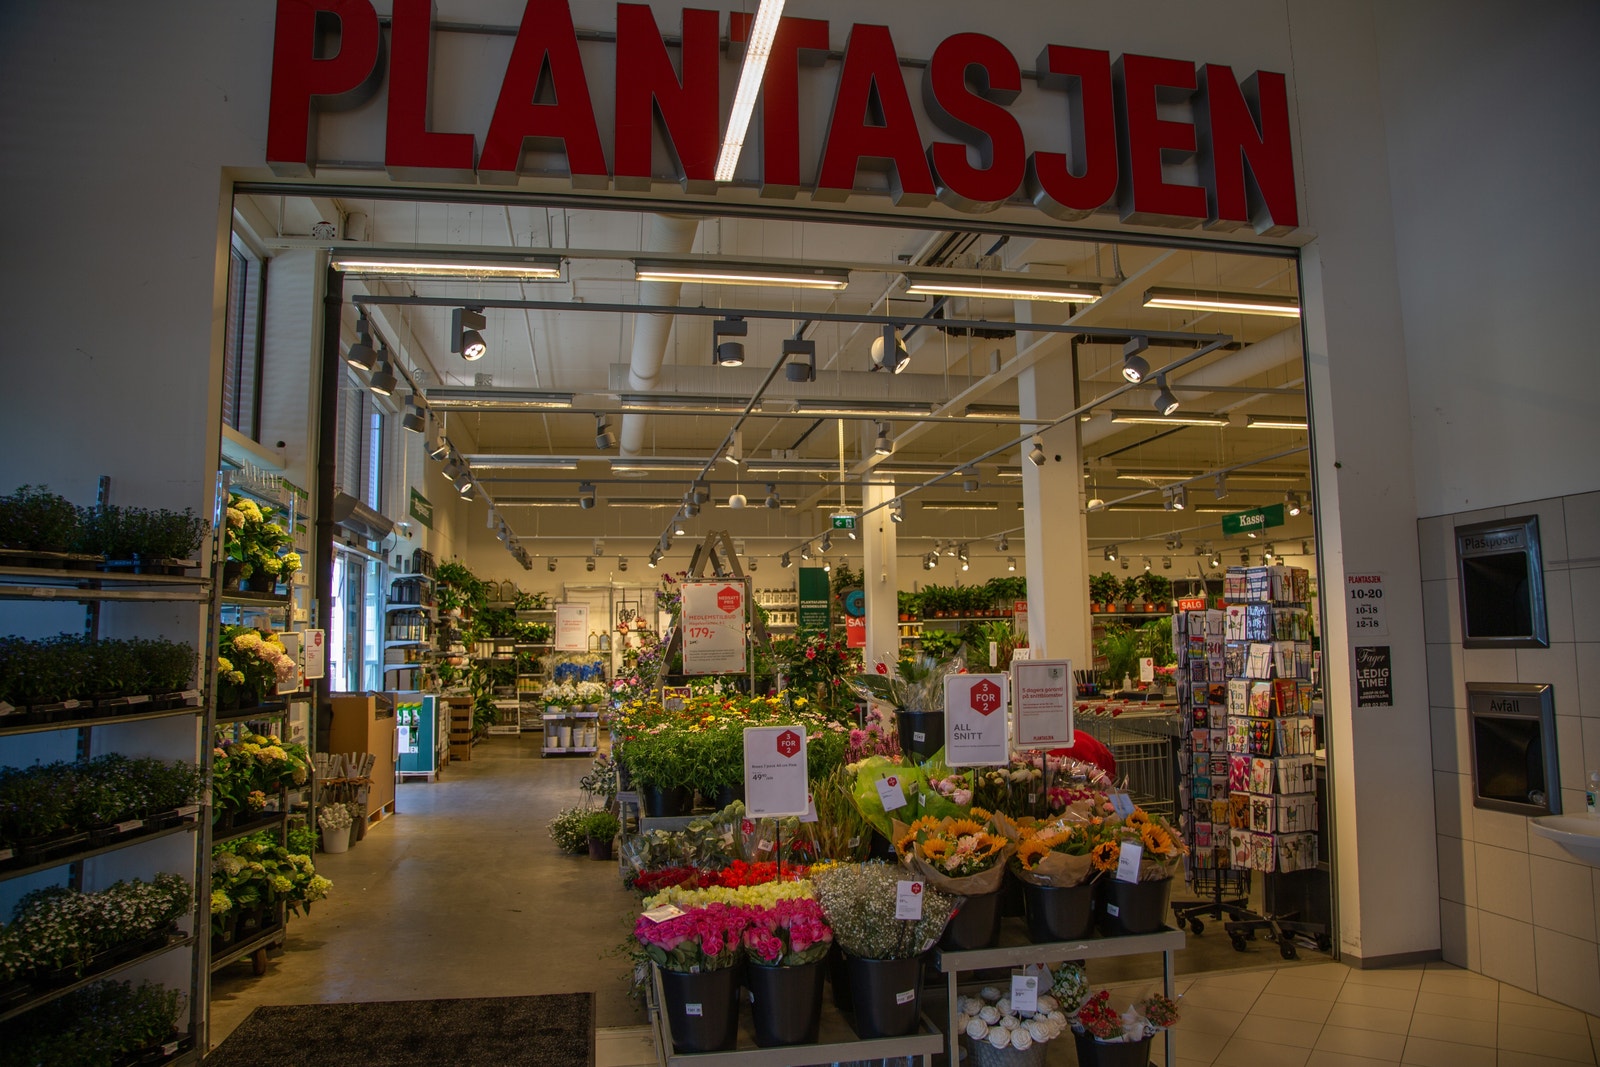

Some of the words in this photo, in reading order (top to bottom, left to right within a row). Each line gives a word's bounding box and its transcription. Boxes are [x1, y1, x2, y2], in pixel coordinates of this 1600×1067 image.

[267, 0, 1299, 230] PLANTASJEN
[1239, 514, 1265, 527] Kasse
[1465, 532, 1520, 550] Plastposer
[1348, 576, 1382, 584] PLANTASJEN
[1351, 589, 1383, 599] 10-20
[1182, 601, 1202, 609] SALG
[690, 627, 715, 639] 179,-
[1358, 648, 1386, 668] Fager
[1357, 668, 1389, 679] LEDIG
[983, 684, 988, 692] 3
[1359, 677, 1387, 688] TIME!
[976, 694, 995, 702] FOR
[1490, 700, 1520, 712] Avfall
